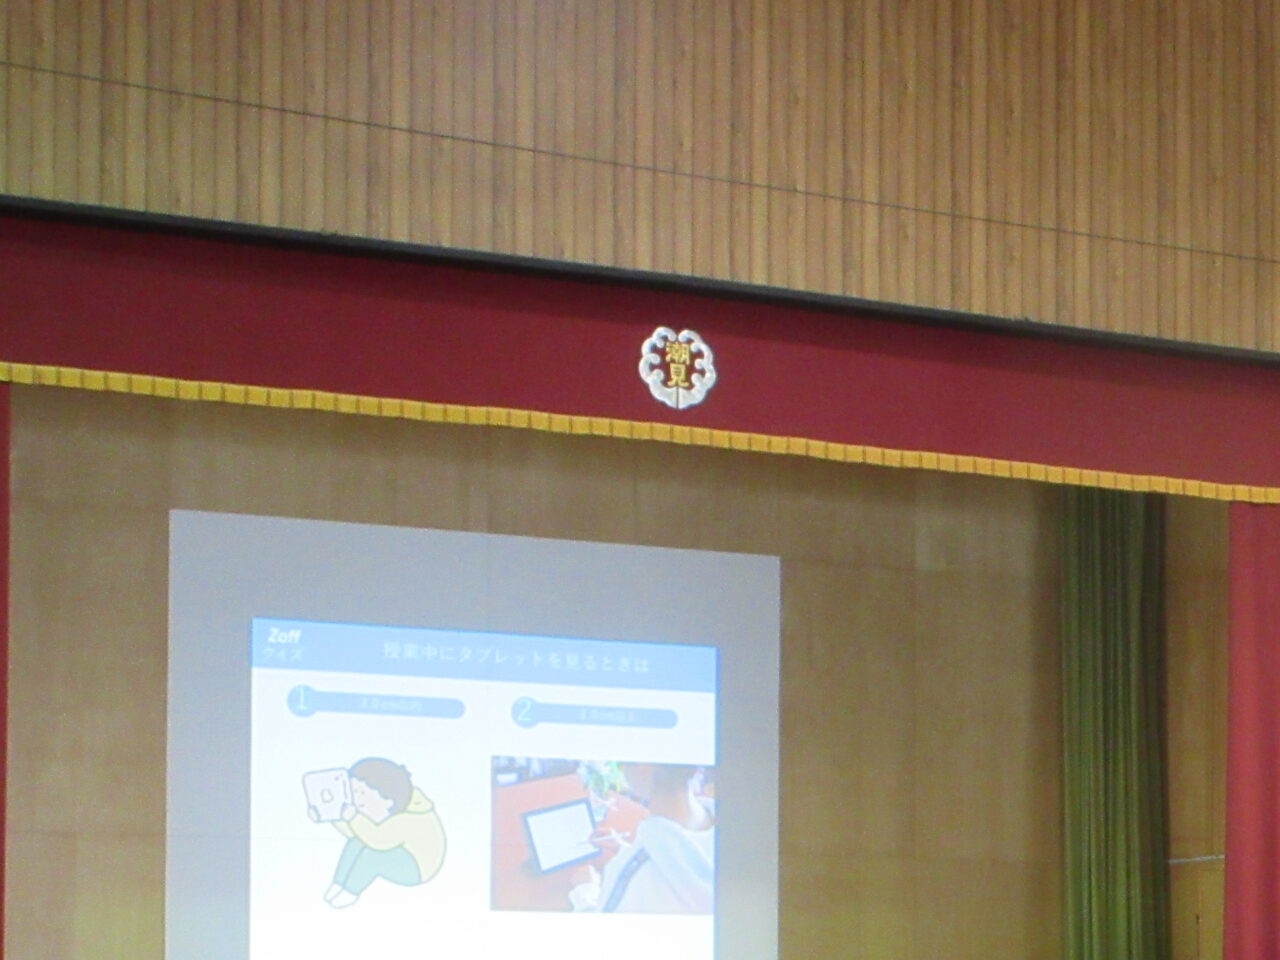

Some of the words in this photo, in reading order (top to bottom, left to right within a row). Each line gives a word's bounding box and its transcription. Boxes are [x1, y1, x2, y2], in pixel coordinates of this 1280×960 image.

[268, 627, 301, 645] Zoff
[383, 641, 650, 673] 授業中にタブレットを見るときは
[517, 698, 532, 721] 2
